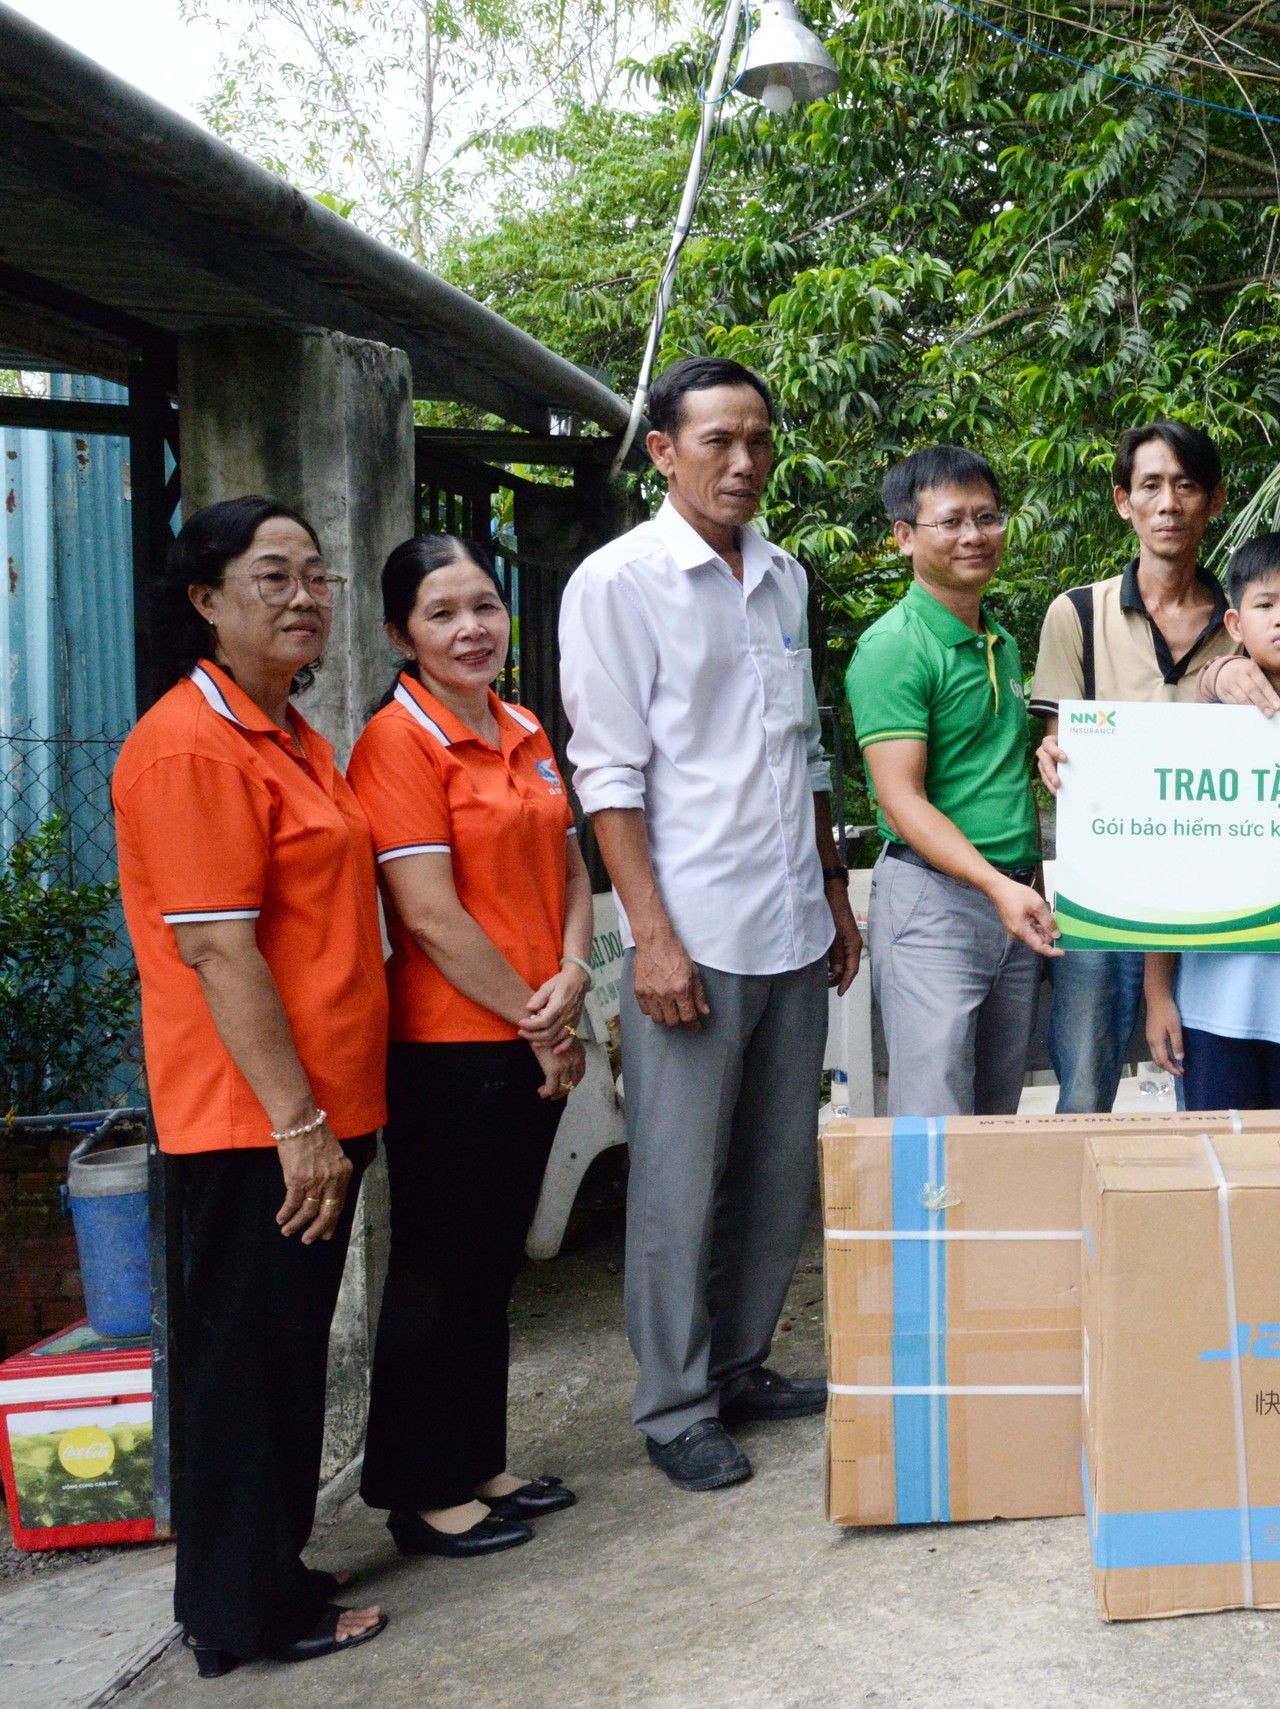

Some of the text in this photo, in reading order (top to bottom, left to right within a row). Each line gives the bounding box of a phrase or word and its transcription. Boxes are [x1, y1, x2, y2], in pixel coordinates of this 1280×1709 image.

[1070, 710, 1116, 727] NNX
[1070, 727, 1116, 735] INSURANCE
[1154, 768, 1239, 802] TRAO
[1091, 818, 1124, 836] Gói
[1131, 817, 1167, 836] bảo
[1174, 817, 1222, 837] hiểm
[1228, 819, 1265, 837] sức
